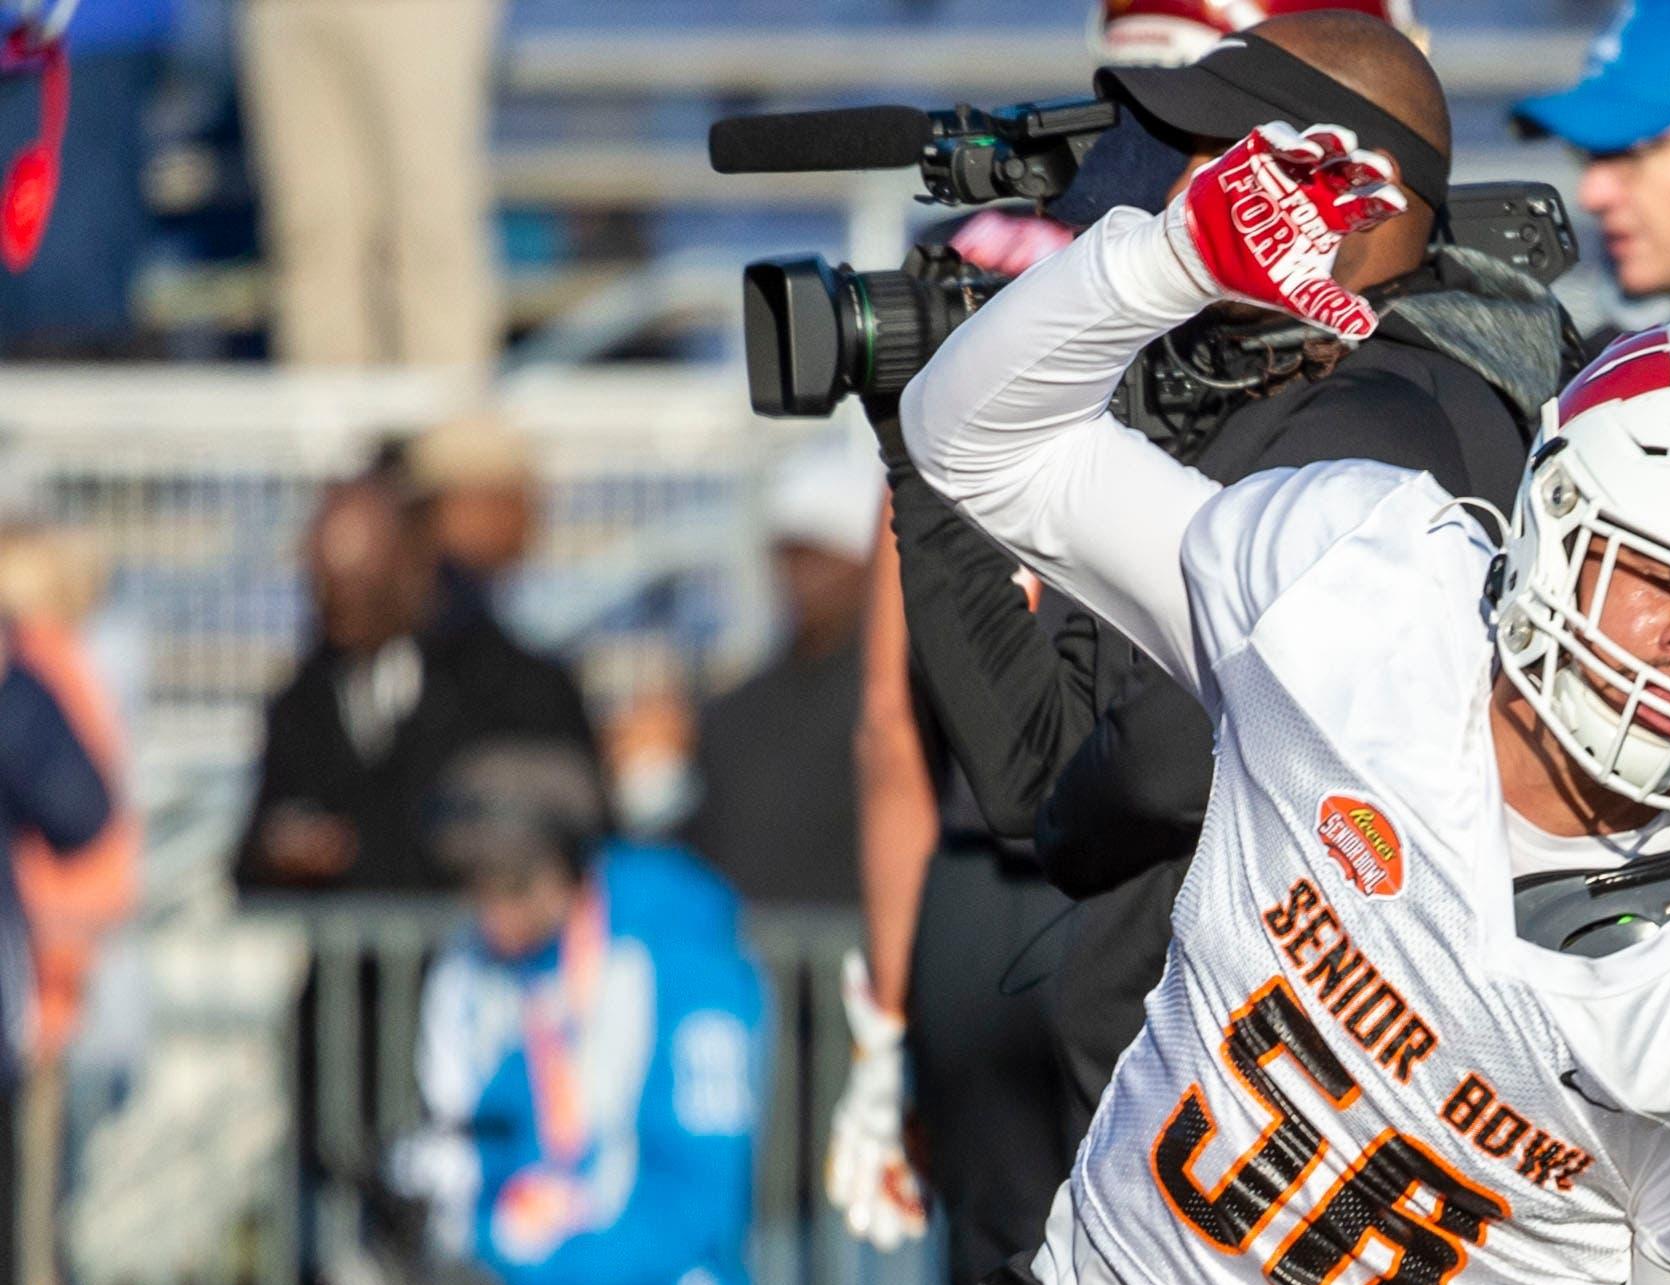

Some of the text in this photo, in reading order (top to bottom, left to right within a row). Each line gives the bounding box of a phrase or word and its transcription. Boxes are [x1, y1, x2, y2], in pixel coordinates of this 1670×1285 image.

[1317, 811, 1388, 897] SENIOR BOWL
[1263, 878, 1597, 1191] SENIOR BOWL
